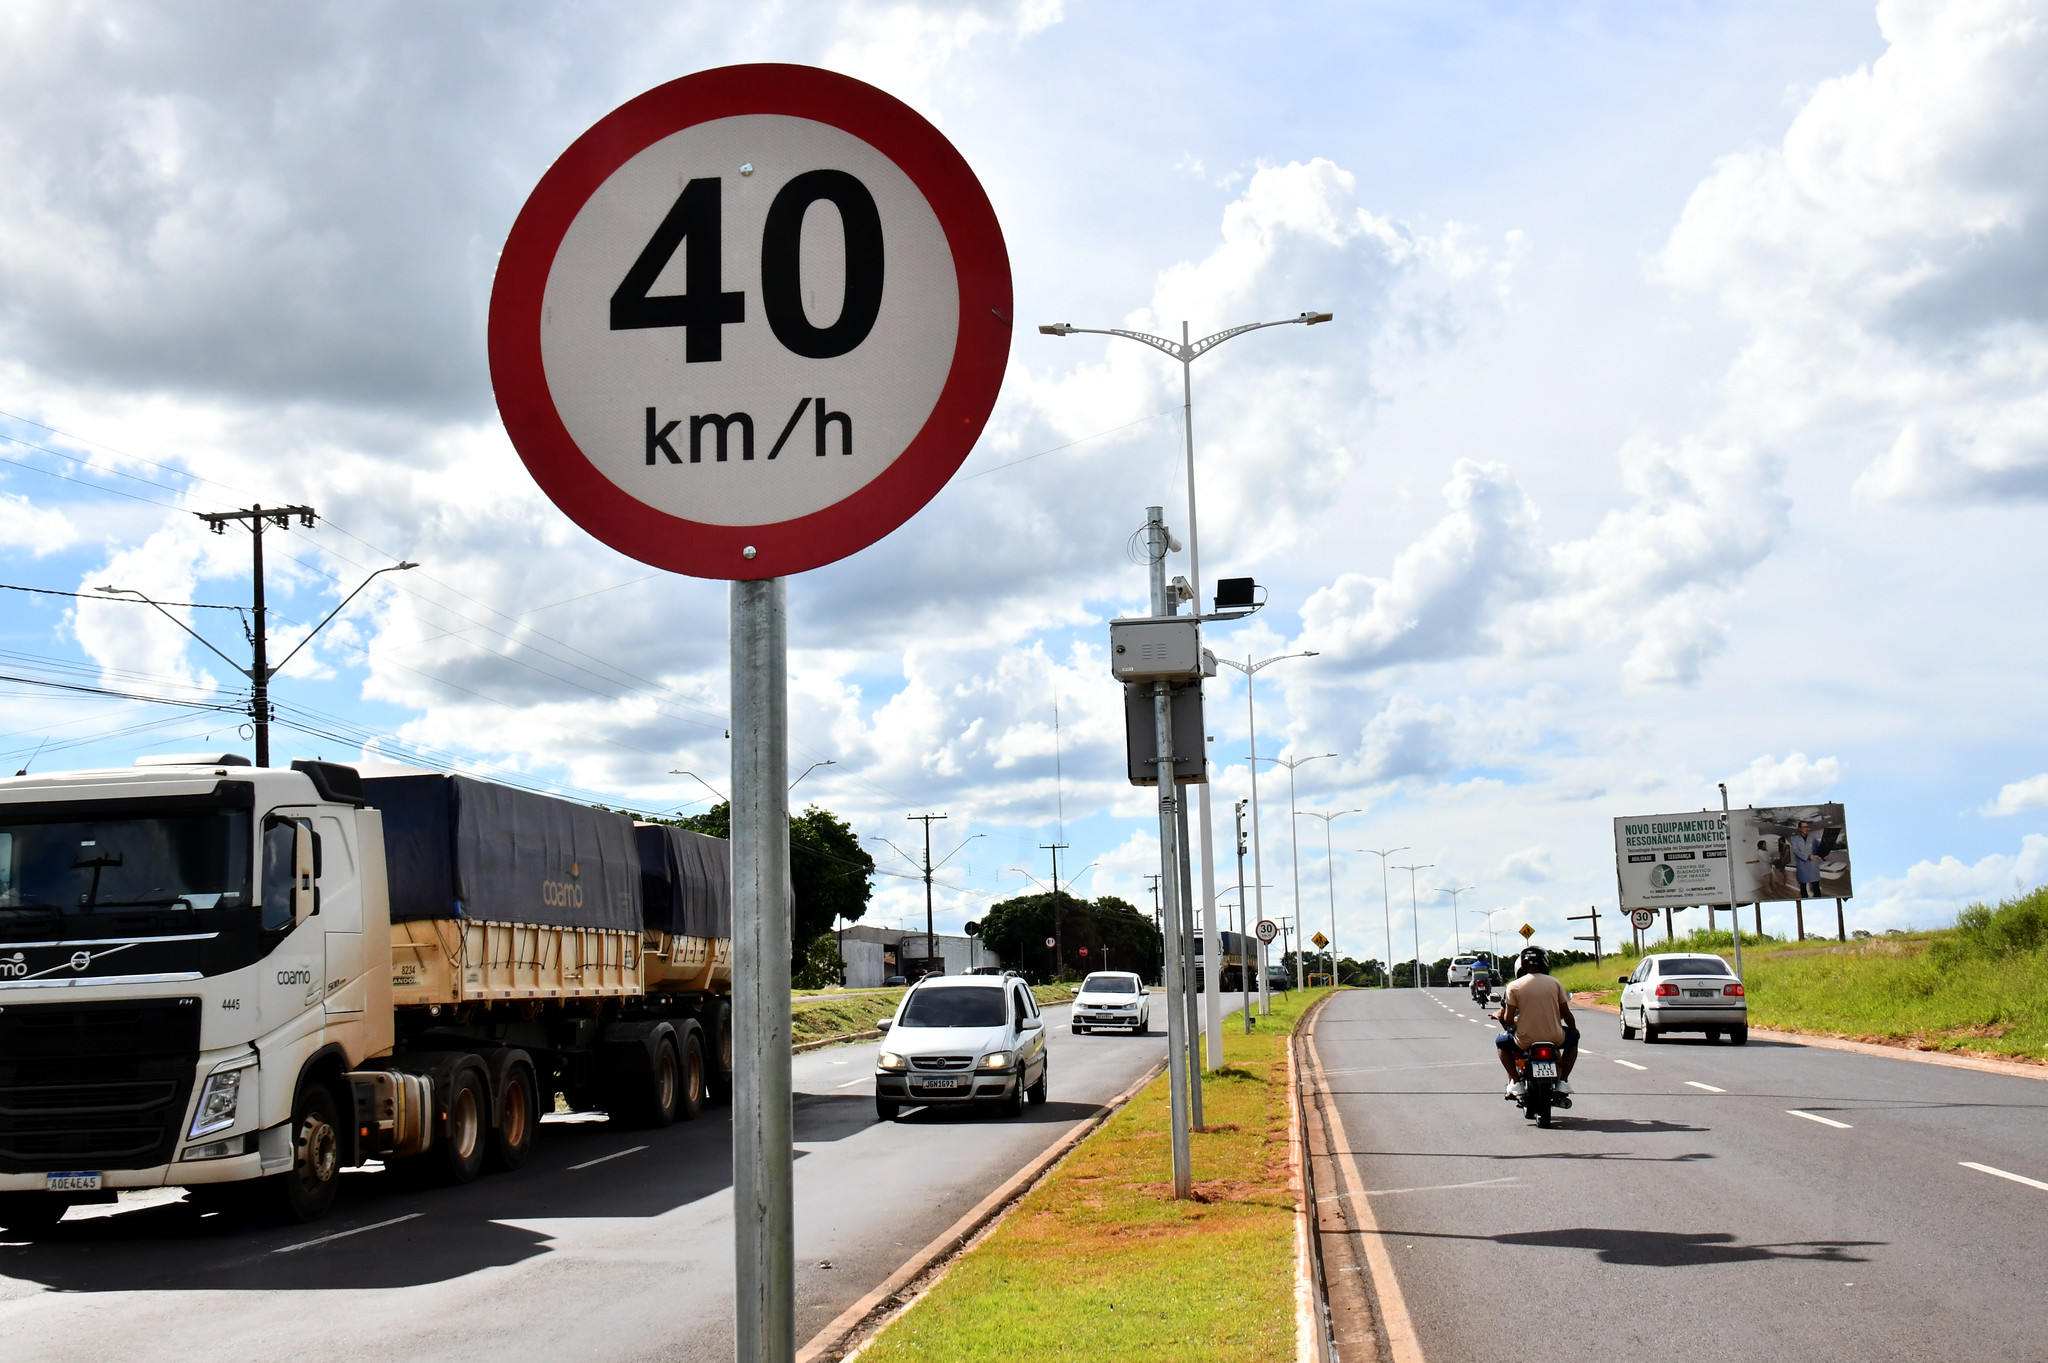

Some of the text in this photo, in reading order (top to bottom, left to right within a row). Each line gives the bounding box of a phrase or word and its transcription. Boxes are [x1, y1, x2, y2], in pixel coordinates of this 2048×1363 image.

[610, 169, 885, 363] 40
[646, 398, 853, 465] km/h
[1625, 823, 1649, 835] NOVO
[1652, 820, 1715, 834] EQUIPAMENTO
[1626, 831, 1725, 846] RESSONÂNCIA MAGNÉTIC
[543, 881, 583, 909] coamo
[1636, 912, 1648, 921] 30
[1260, 924, 1272, 933] 30
[277, 970, 310, 985] coamo
[402, 965, 416, 975] 8234
[222, 999, 240, 1010] 4445
